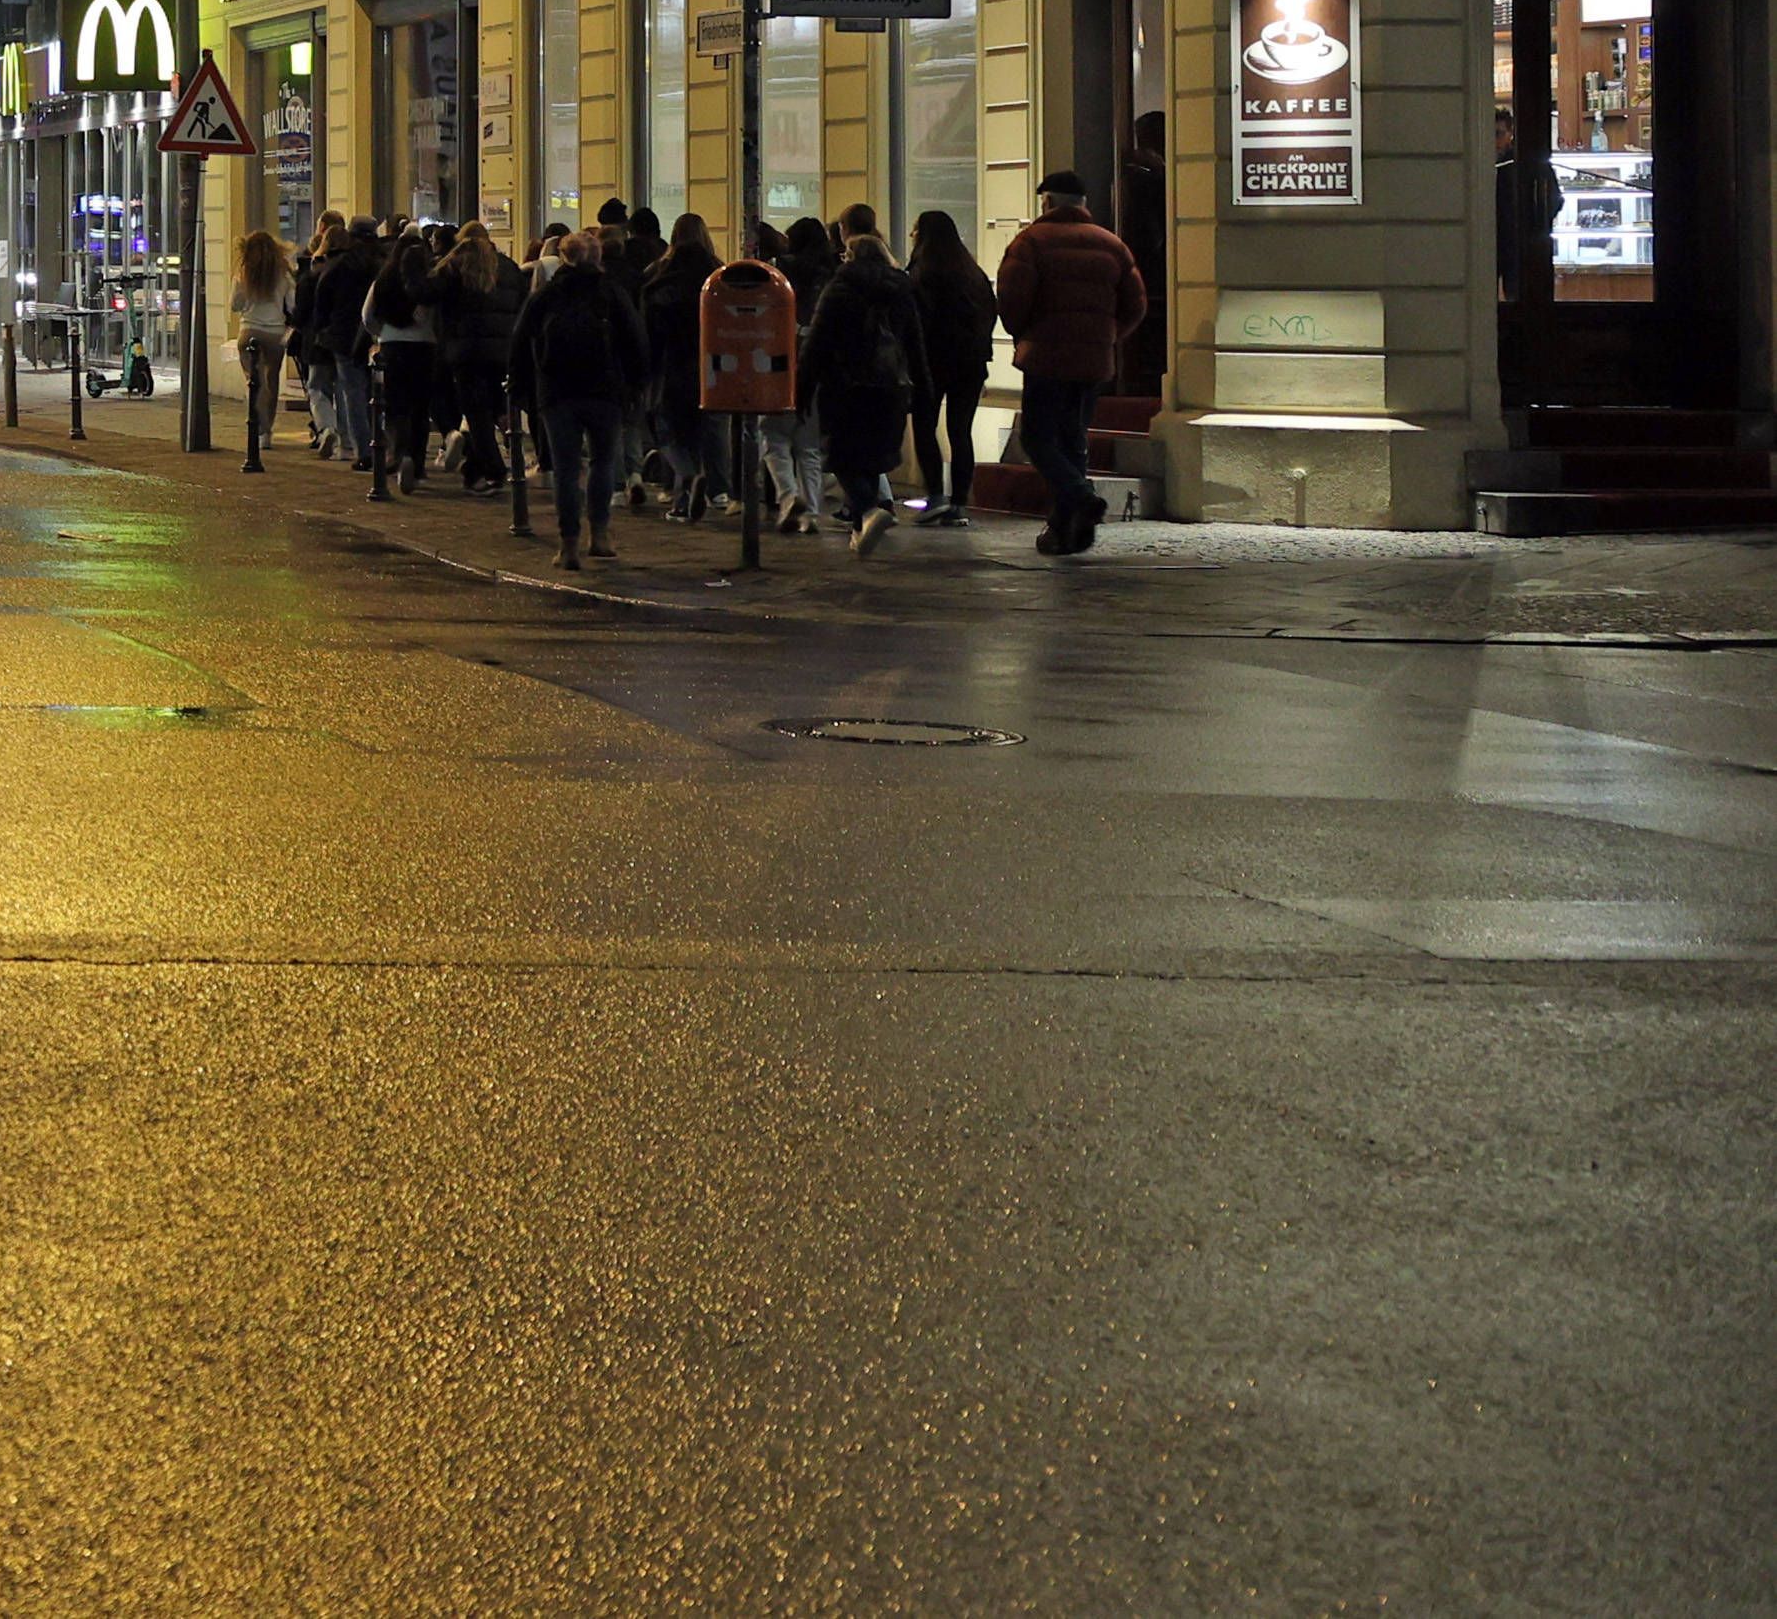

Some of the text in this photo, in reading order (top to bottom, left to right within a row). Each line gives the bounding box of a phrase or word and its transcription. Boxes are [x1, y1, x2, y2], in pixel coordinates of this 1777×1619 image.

[1244, 98, 1348, 114] KAFFEE
[1245, 163, 1349, 174] CHECKPOINT
[1246, 175, 1349, 190] CHARLIE
